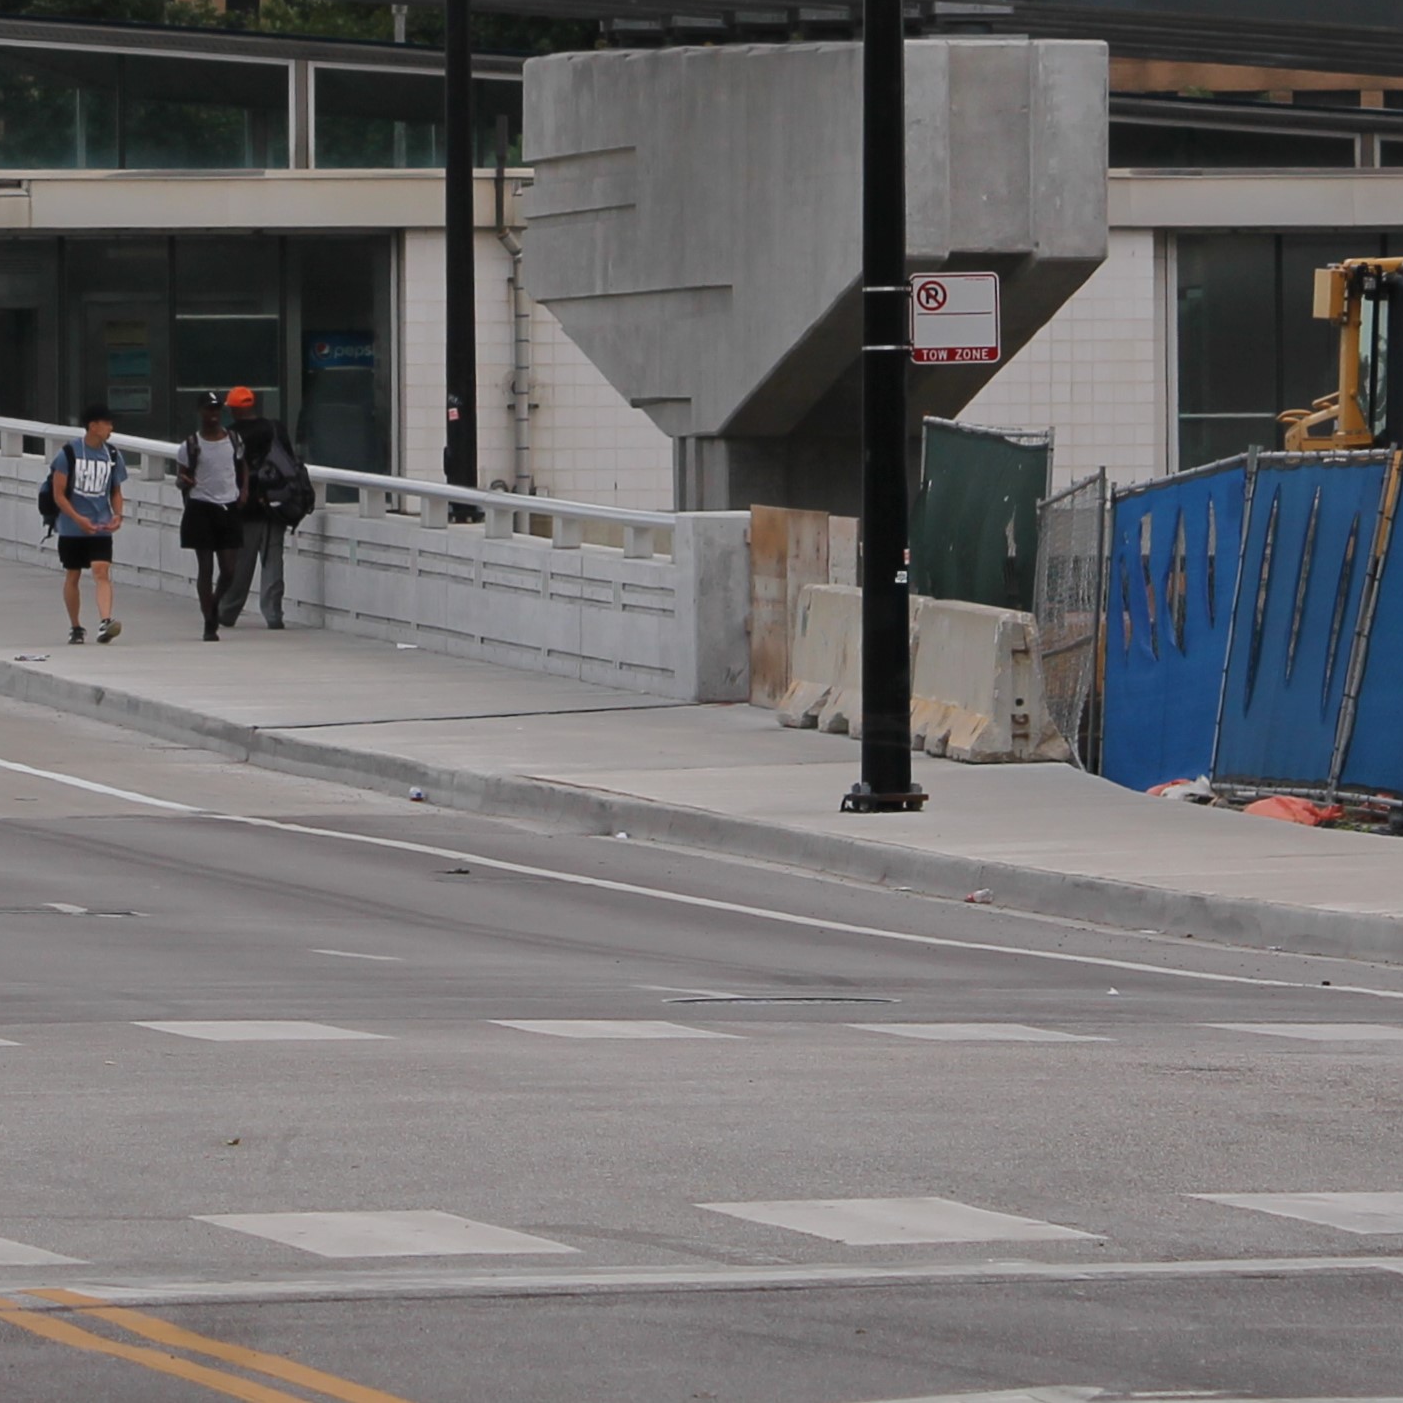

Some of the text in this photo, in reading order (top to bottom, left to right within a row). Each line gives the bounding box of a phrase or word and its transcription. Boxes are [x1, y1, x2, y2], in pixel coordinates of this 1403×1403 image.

[334, 344, 373, 359] peps
[922, 349, 989, 361] TOW ZONE
